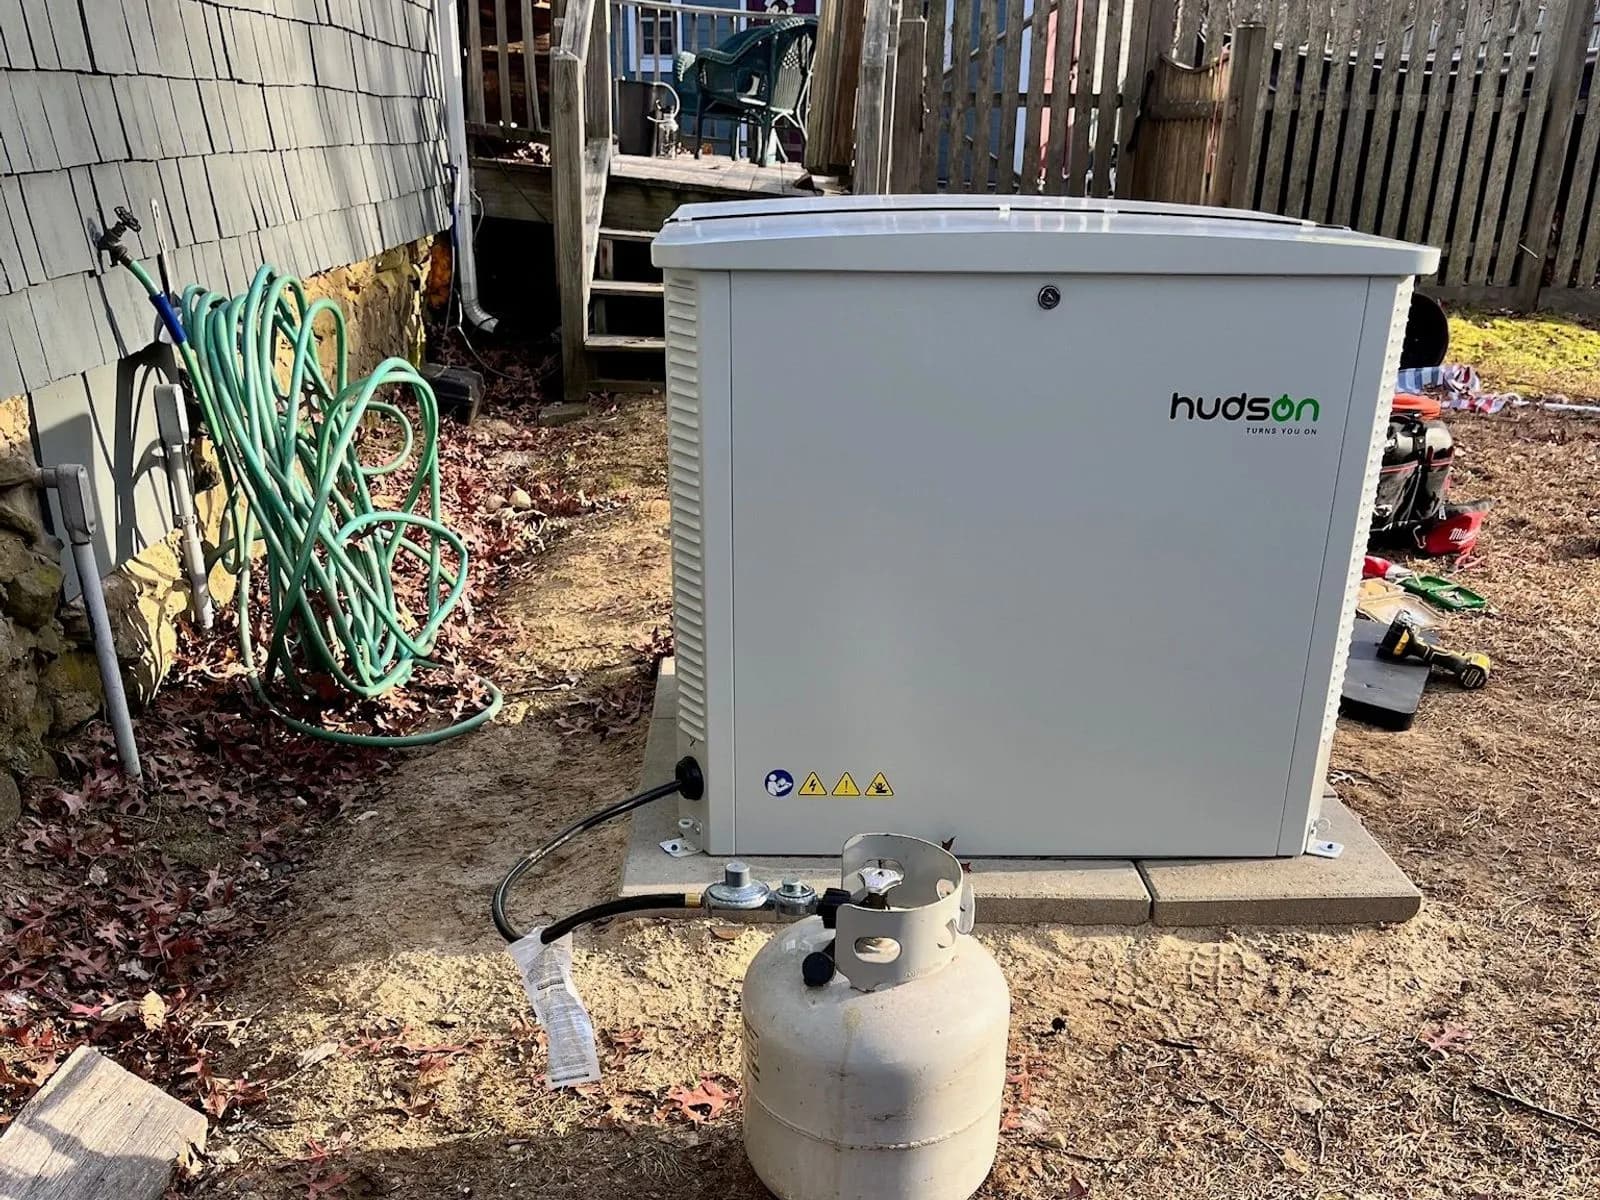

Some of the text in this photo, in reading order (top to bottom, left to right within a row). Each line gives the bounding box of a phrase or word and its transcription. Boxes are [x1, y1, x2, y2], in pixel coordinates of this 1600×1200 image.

[1169, 392, 1320, 422] hudson
[1246, 427, 1277, 435] TURNS
[1281, 427, 1300, 435] YOU
